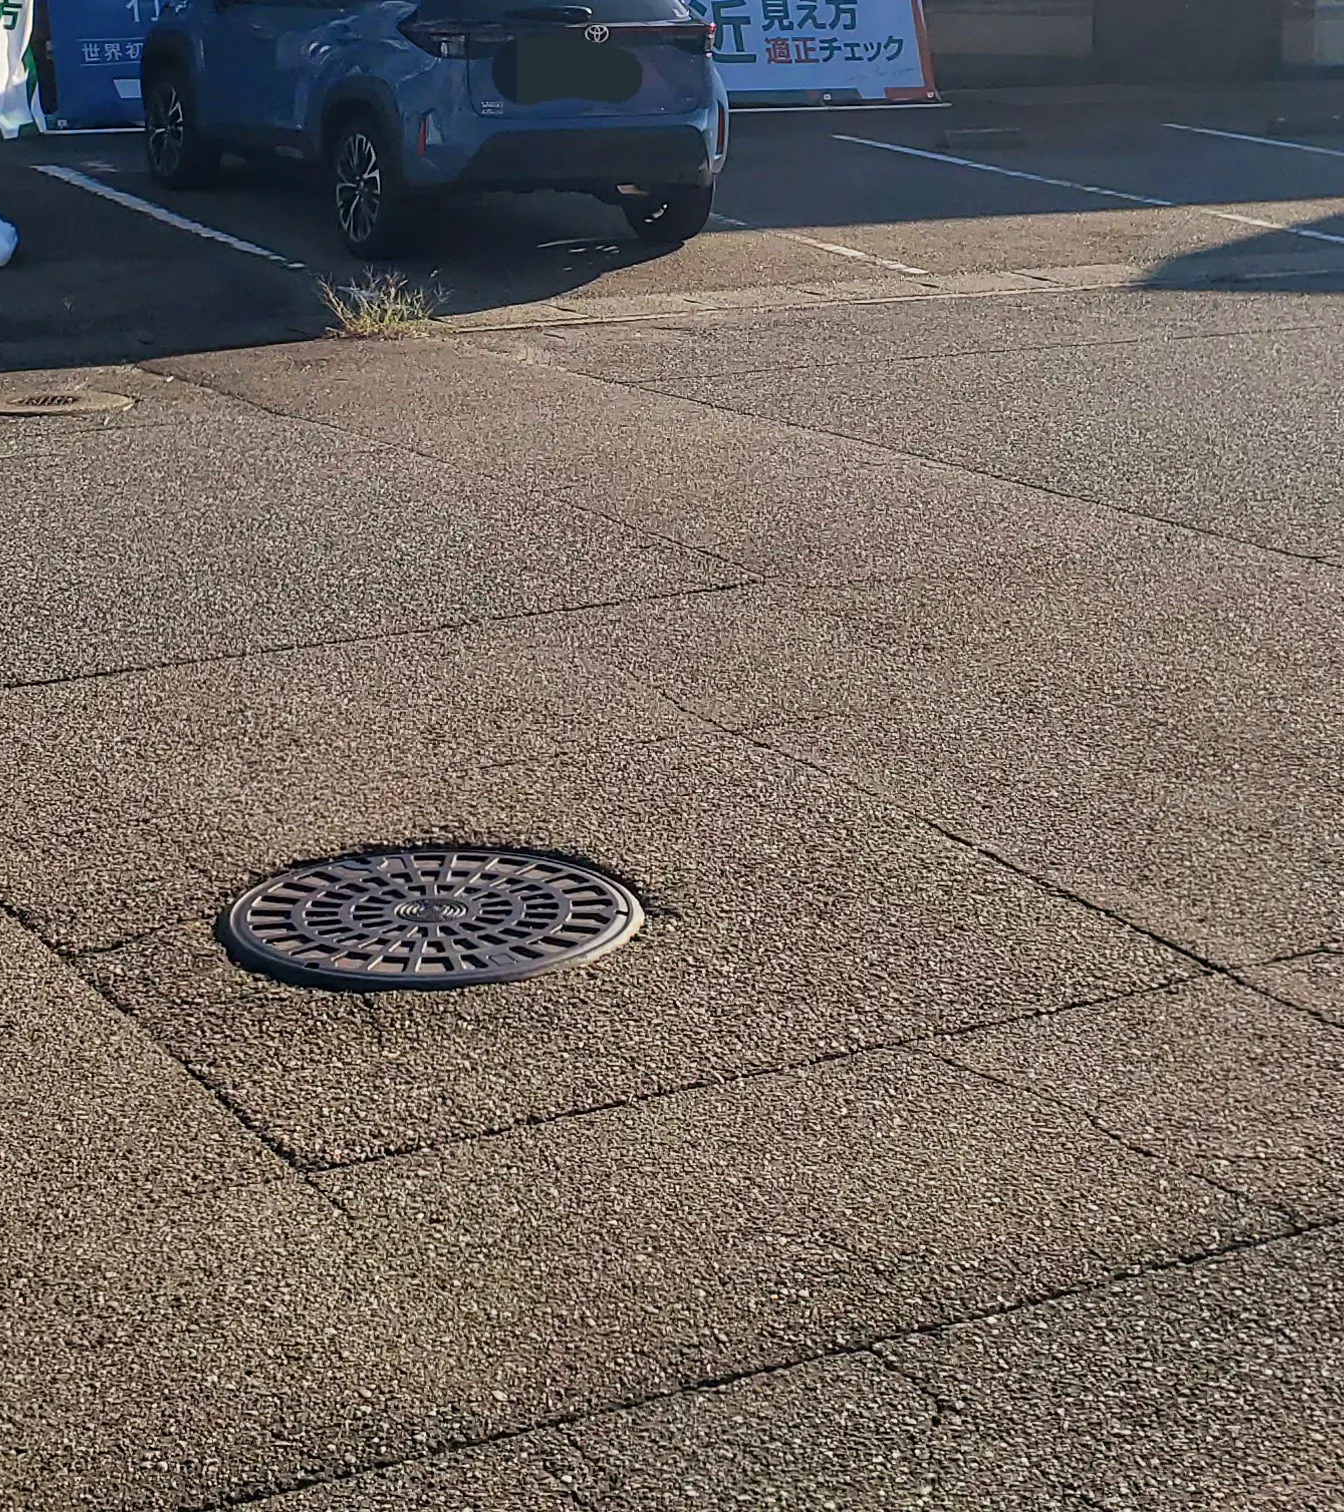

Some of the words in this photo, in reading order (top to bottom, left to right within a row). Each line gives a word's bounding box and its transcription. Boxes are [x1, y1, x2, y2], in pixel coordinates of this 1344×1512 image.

[80, 41, 146, 63] 世界初
[764, 35, 905, 65] 適正チェック
